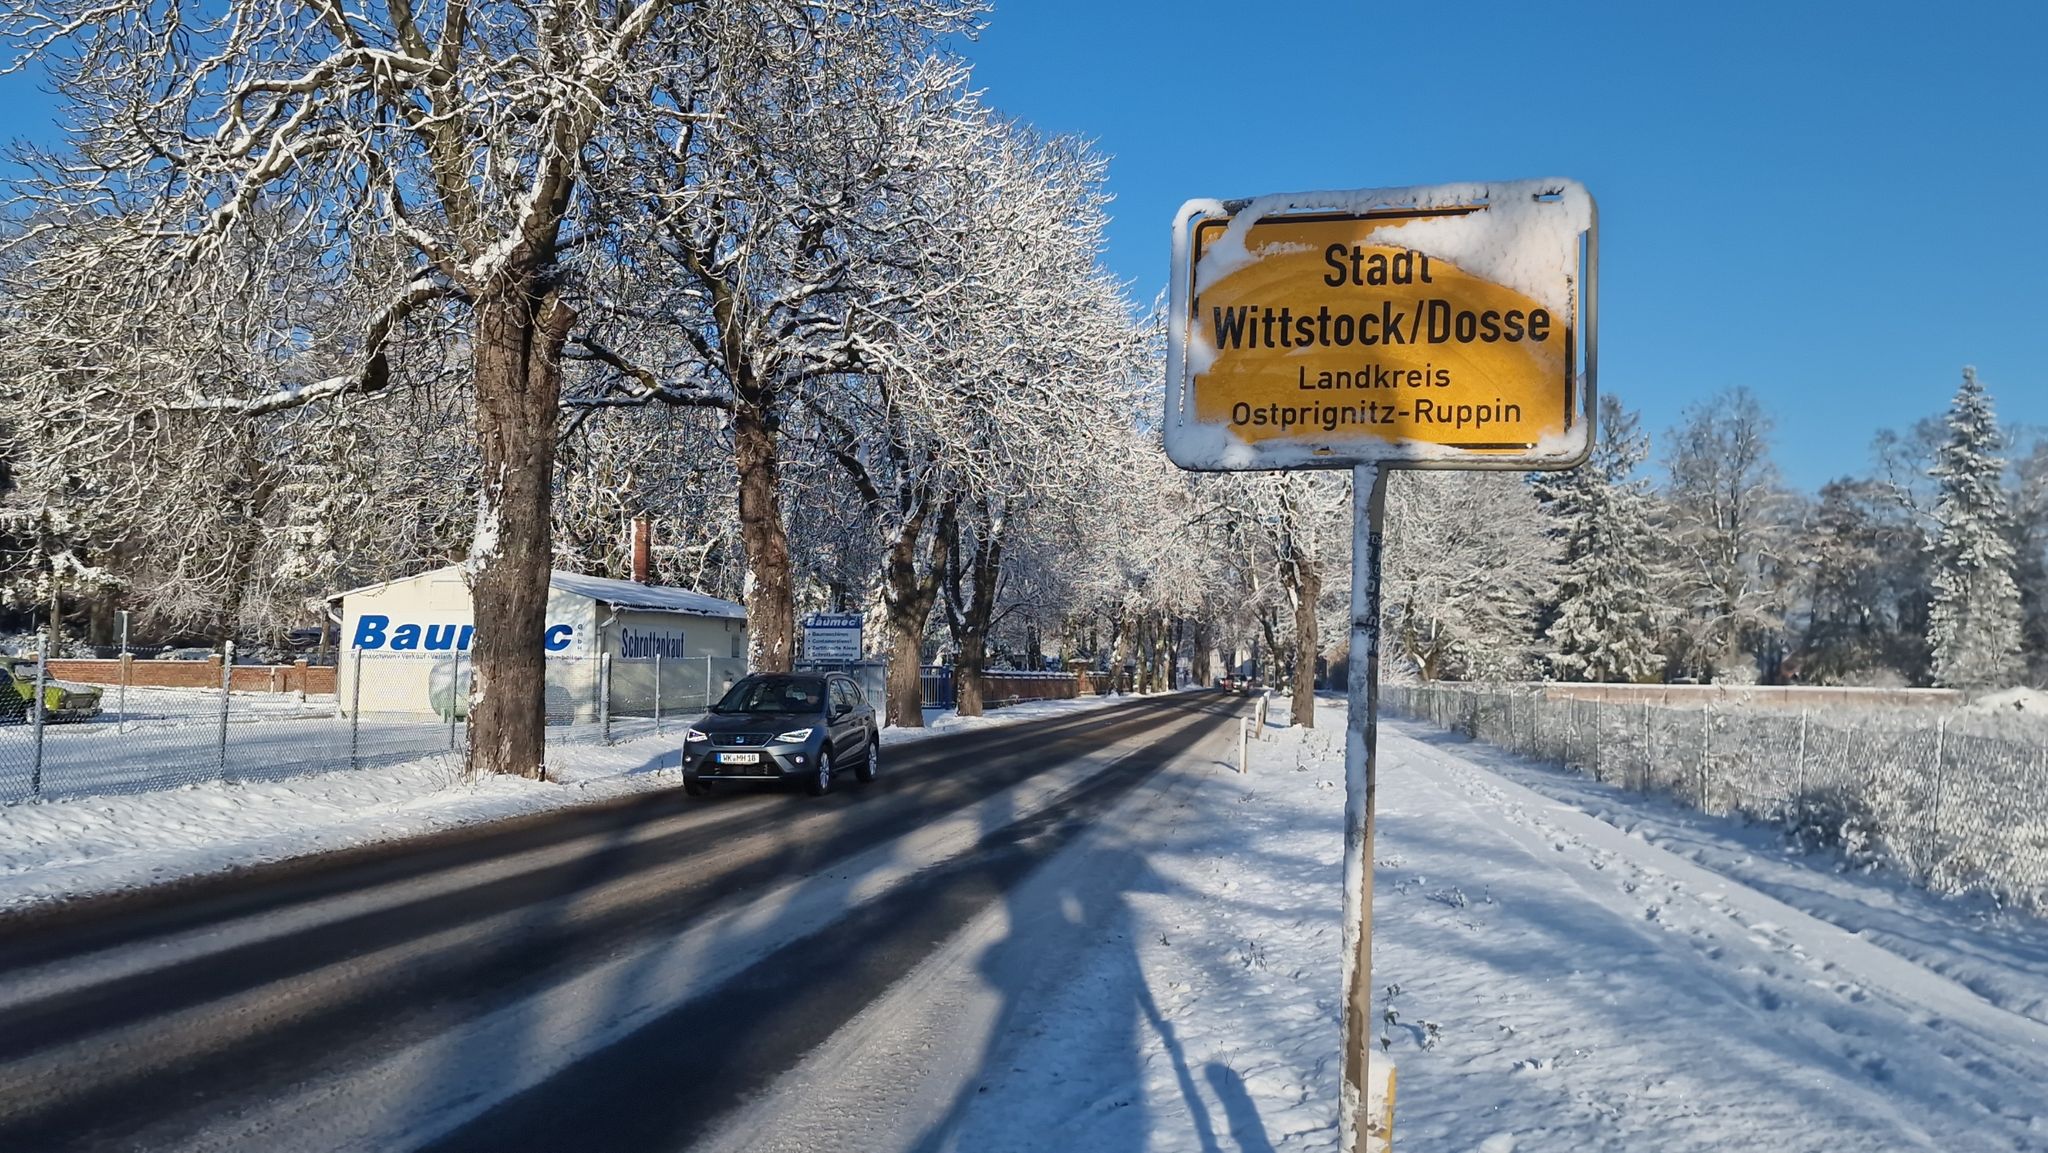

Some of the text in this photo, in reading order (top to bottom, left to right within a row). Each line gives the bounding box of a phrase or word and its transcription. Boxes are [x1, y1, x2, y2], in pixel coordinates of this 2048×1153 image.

[1323, 243, 1433, 288] Stadt
[1212, 298, 1551, 350] Wittstock/Dosse
[1299, 363, 1451, 391] Landkreis
[1232, 397, 1522, 432] Ostprignitz-Ruppin
[351, 614, 573, 651] Bauc
[621, 627, 685, 659] Schrottankauf
